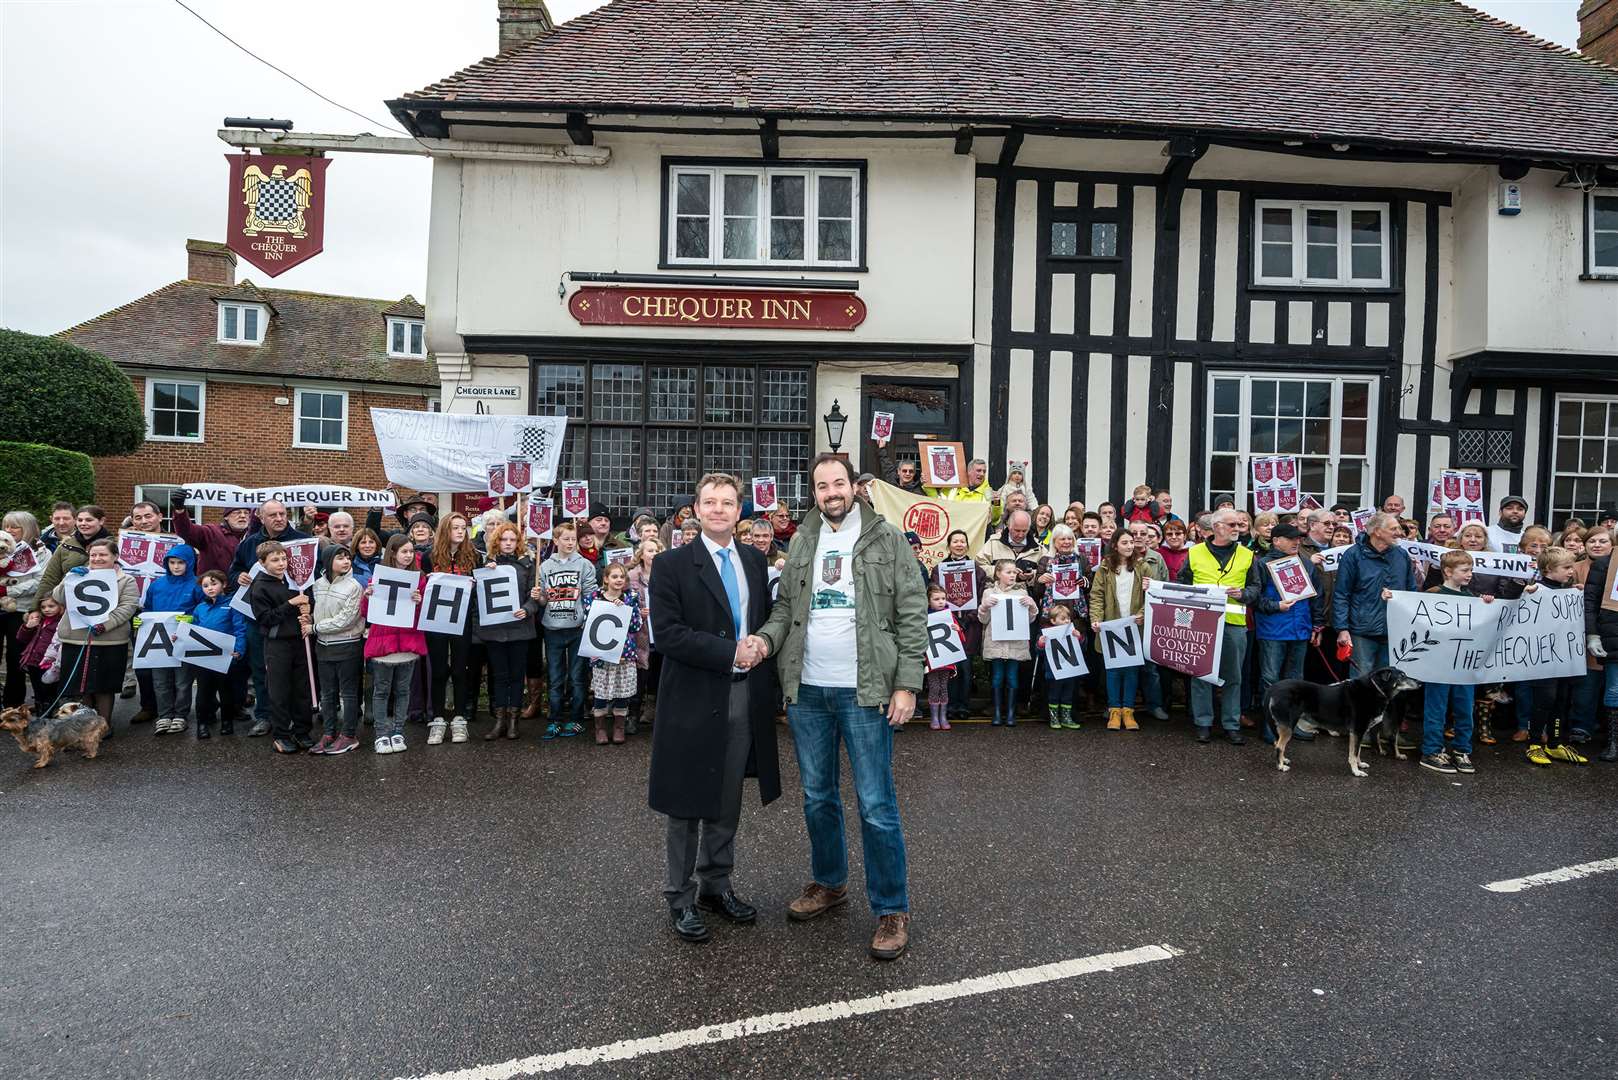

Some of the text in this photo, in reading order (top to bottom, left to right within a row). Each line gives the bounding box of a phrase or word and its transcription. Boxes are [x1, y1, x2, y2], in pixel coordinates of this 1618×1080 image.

[251, 243, 297, 252] CHEQUER
[265, 252, 283, 260] INN
[622, 296, 812, 322] CHEQUER INN
[456, 386, 492, 395] CHEQUER
[184, 488, 390, 505] SAVE THE CHEQUER INN
[122, 548, 147, 556] SAVE
[289, 555, 312, 564] INTS
[1325, 553, 1344, 566] SA
[1493, 559, 1528, 572] INN
[549, 572, 578, 587] VANS
[823, 568, 841, 577] SAVE
[1283, 575, 1305, 586] SAVE
[74, 579, 110, 616] S
[1411, 600, 1472, 631] ASH
[137, 622, 174, 658] A
[588, 613, 623, 650] C
[927, 623, 961, 658] R
[1153, 625, 1214, 644] COMMUNITY
[1156, 637, 1207, 656] COMES
[1449, 638, 1485, 671] THE
[1162, 649, 1200, 666] FIRST
